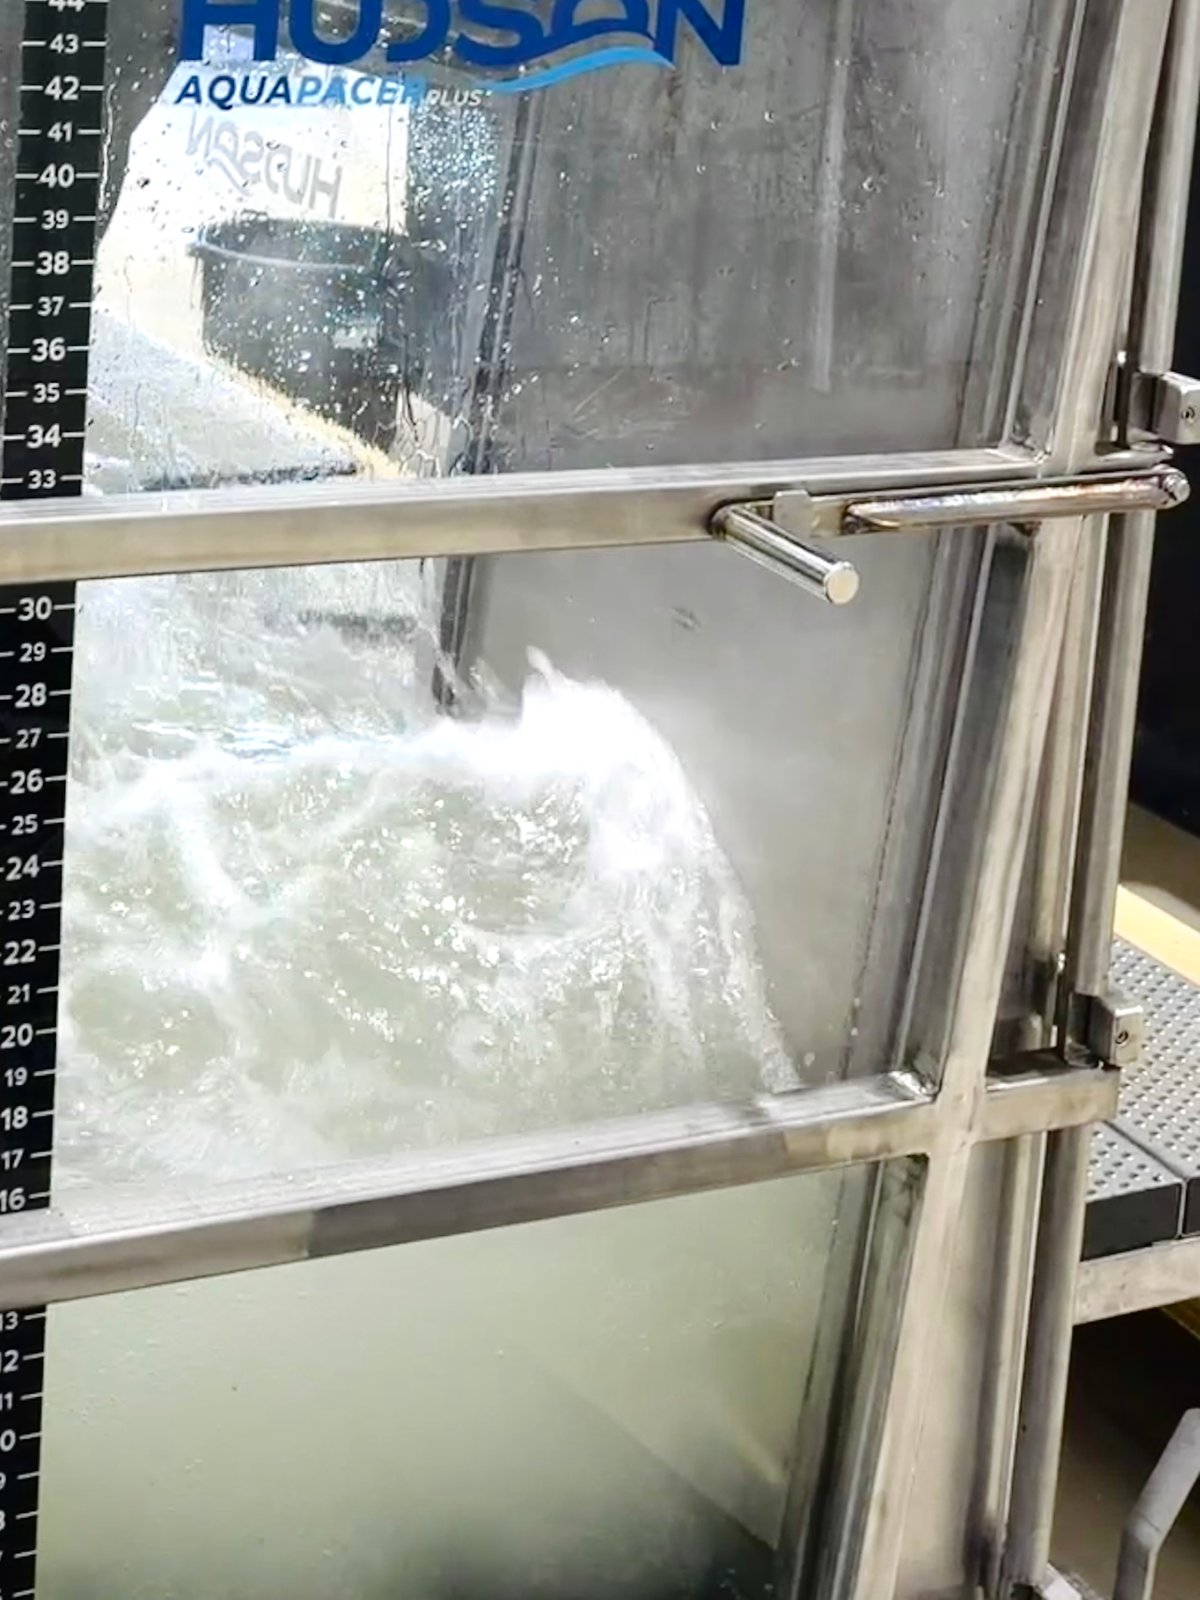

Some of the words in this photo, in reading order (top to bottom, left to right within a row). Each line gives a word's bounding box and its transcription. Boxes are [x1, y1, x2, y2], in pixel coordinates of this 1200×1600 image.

[49, 32, 81, 55] 43
[43, 74, 81, 102] 42
[174, 73, 429, 110] AQUAPACER
[45, 120, 75, 144] 41
[39, 162, 76, 189] 40
[40, 208, 71, 231] 39
[35, 250, 71, 276] 38
[36, 295, 66, 317] 37
[30, 336, 67, 363] 36
[32, 382, 62, 404] 35
[26, 422, 63, 449] 34
[26, 468, 58, 491] 33
[17, 594, 53, 622] 30
[18, 640, 47, 663] 29
[14, 681, 48, 709] 28
[15, 726, 43, 750] 27
[9, 767, 44, 795] 26
[10, 812, 39, 836] 25
[4, 853, 41, 882] 24
[7, 898, 37, 922] 23
[3, 938, 37, 967] 22
[6, 982, 32, 1006] 21
[0, 1022, 34, 1050] 20
[3, 1066, 29, 1088] 19
[0, 1105, 29, 1131] 18
[0, 1148, 26, 1171] 17
